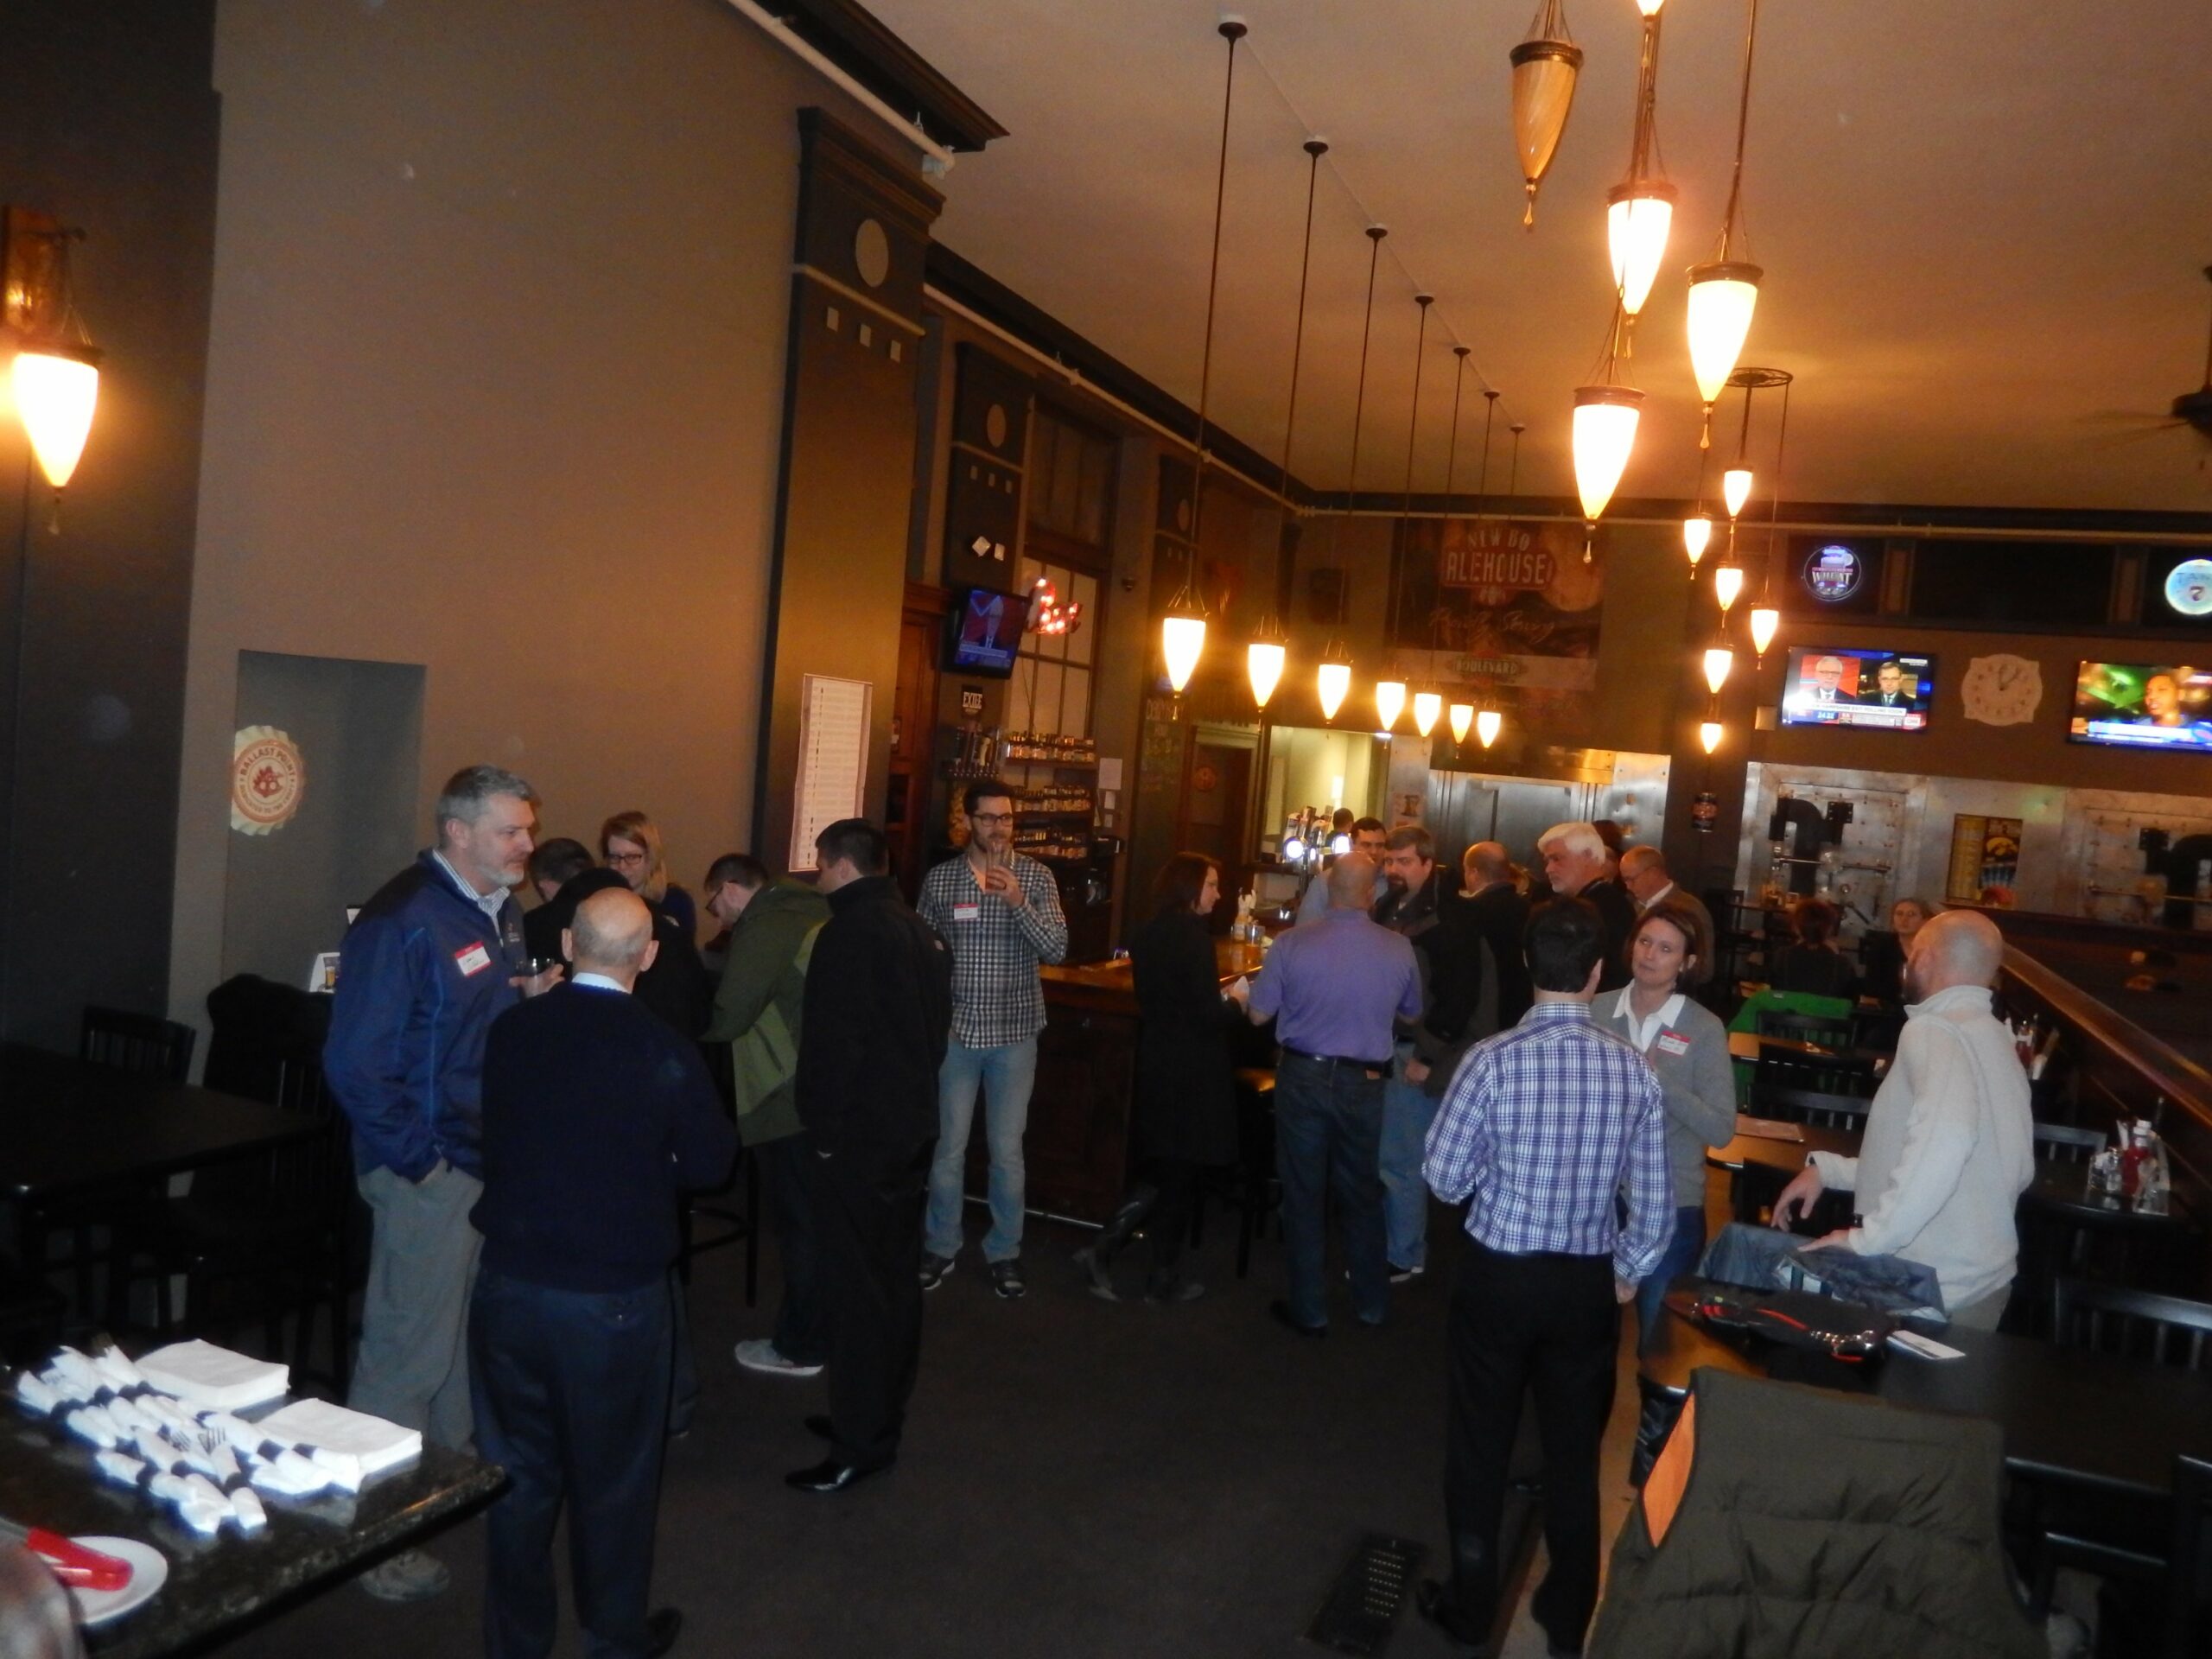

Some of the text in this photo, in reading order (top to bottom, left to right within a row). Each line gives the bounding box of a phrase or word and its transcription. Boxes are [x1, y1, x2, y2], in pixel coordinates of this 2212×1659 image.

[1446, 551, 1548, 585] ALEHOUSE
[2176, 572, 2212, 584] TAN
[1454, 659, 1518, 675] BOULEVARD
[240, 747, 275, 776] BALLAST
